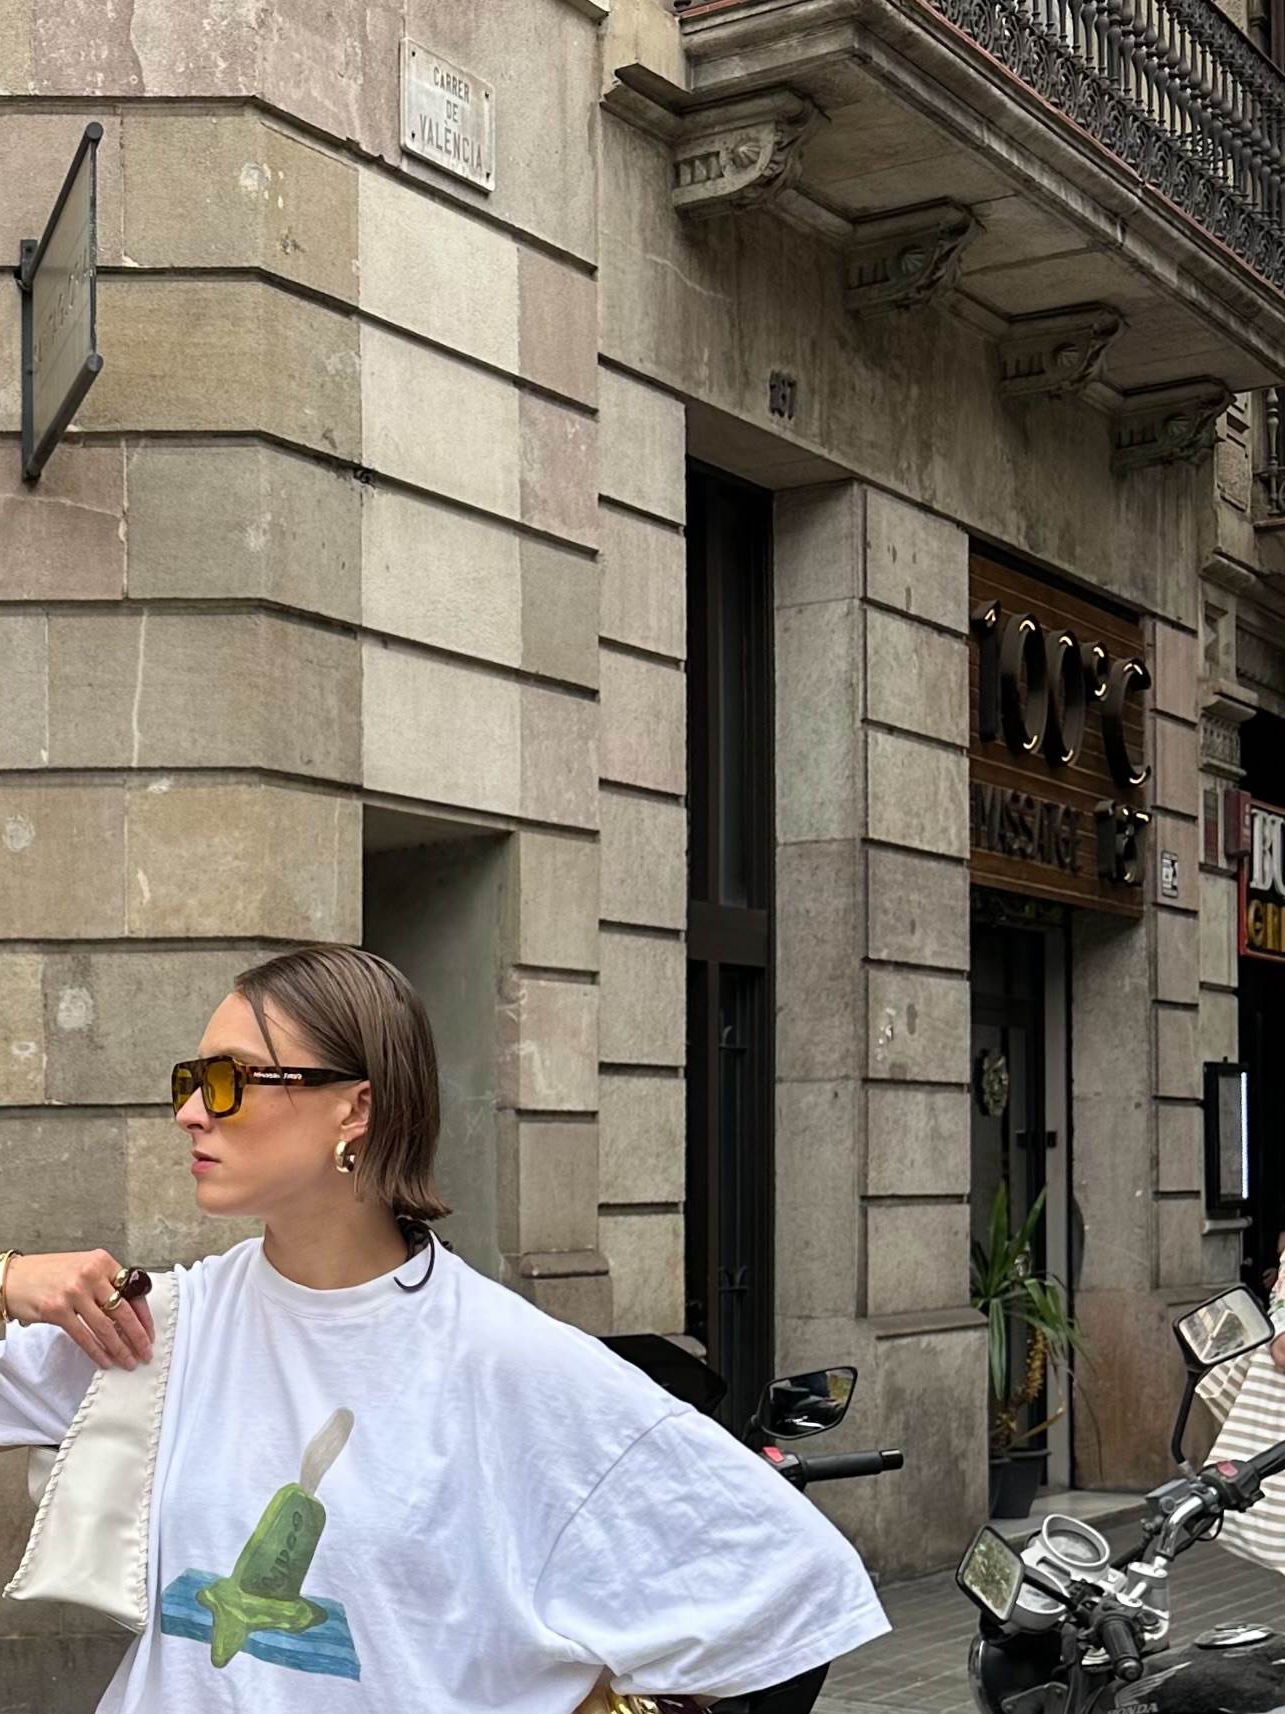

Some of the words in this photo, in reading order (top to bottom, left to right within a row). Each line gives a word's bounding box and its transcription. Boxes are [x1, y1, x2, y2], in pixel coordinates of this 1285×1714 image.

[433, 66, 470, 104] CARRER
[446, 99, 459, 124] DE
[419, 113, 483, 170] VALÈNCIA
